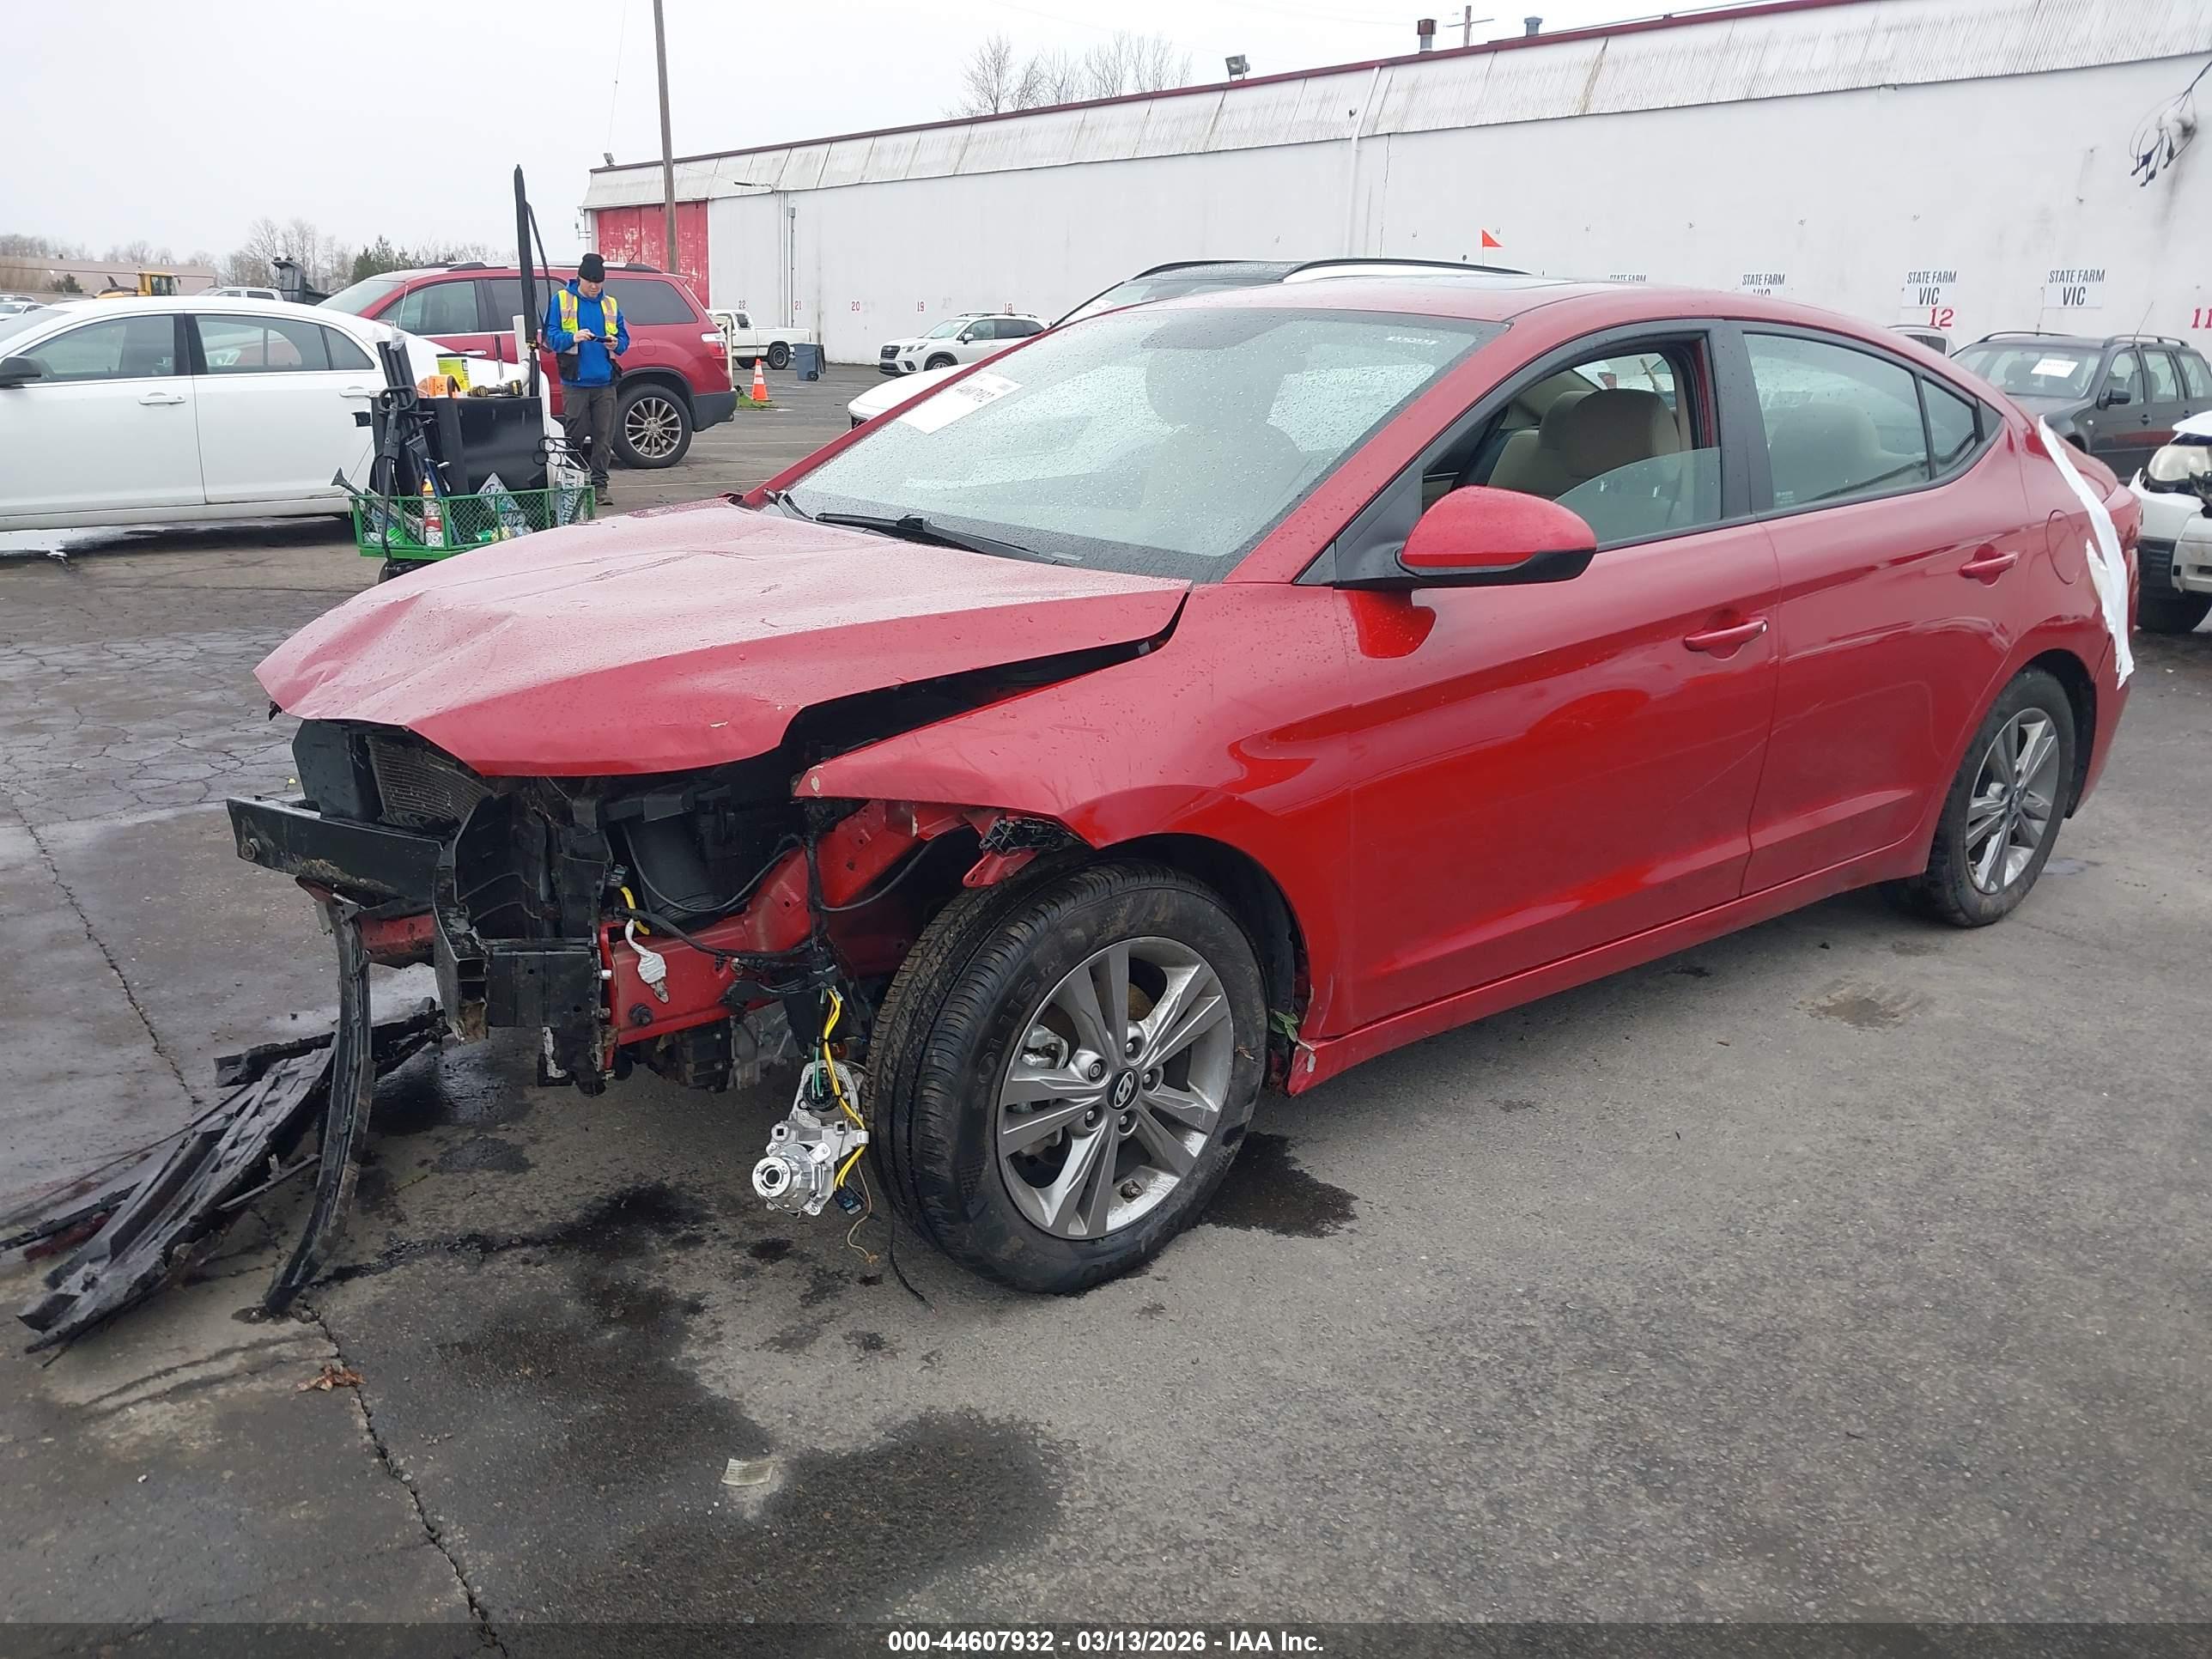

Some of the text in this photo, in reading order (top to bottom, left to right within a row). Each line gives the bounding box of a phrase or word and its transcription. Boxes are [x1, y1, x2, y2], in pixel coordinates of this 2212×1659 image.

[1742, 273, 1785, 286] STATE FARM
[1907, 270, 1957, 284] STATE FARM
[2049, 269, 2106, 283] STATE FARM
[1919, 287, 1940, 306] VIC
[2063, 286, 2087, 306] VIC
[794, 300, 802, 310] 21
[851, 301, 860, 311] 20
[916, 301, 924, 312] 19
[1004, 301, 1012, 313] 18
[1929, 307, 1954, 327] 12
